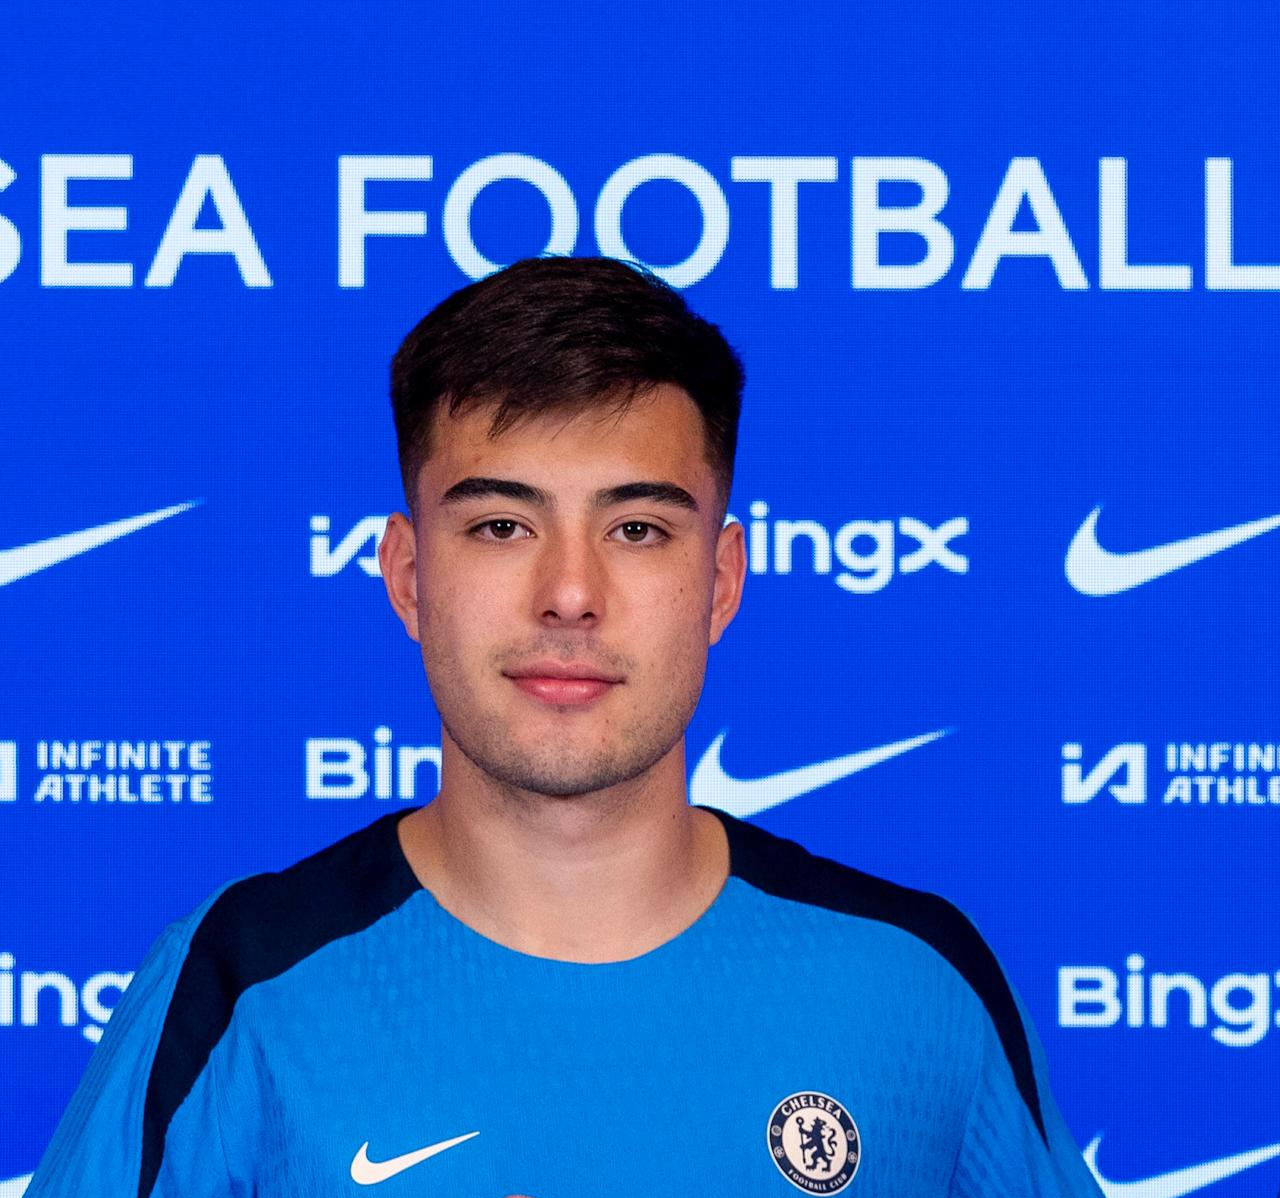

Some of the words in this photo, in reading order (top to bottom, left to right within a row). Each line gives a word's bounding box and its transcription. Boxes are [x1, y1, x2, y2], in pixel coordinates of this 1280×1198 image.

[38, 742, 211, 771] INFINITE
[307, 725, 443, 800] Bin
[36, 775, 212, 803] ATHLETE
[781, 1096, 841, 1119] CHELSEA
[787, 1169, 827, 1190] FOOTBALL
[829, 1173, 848, 1189] CLUB
